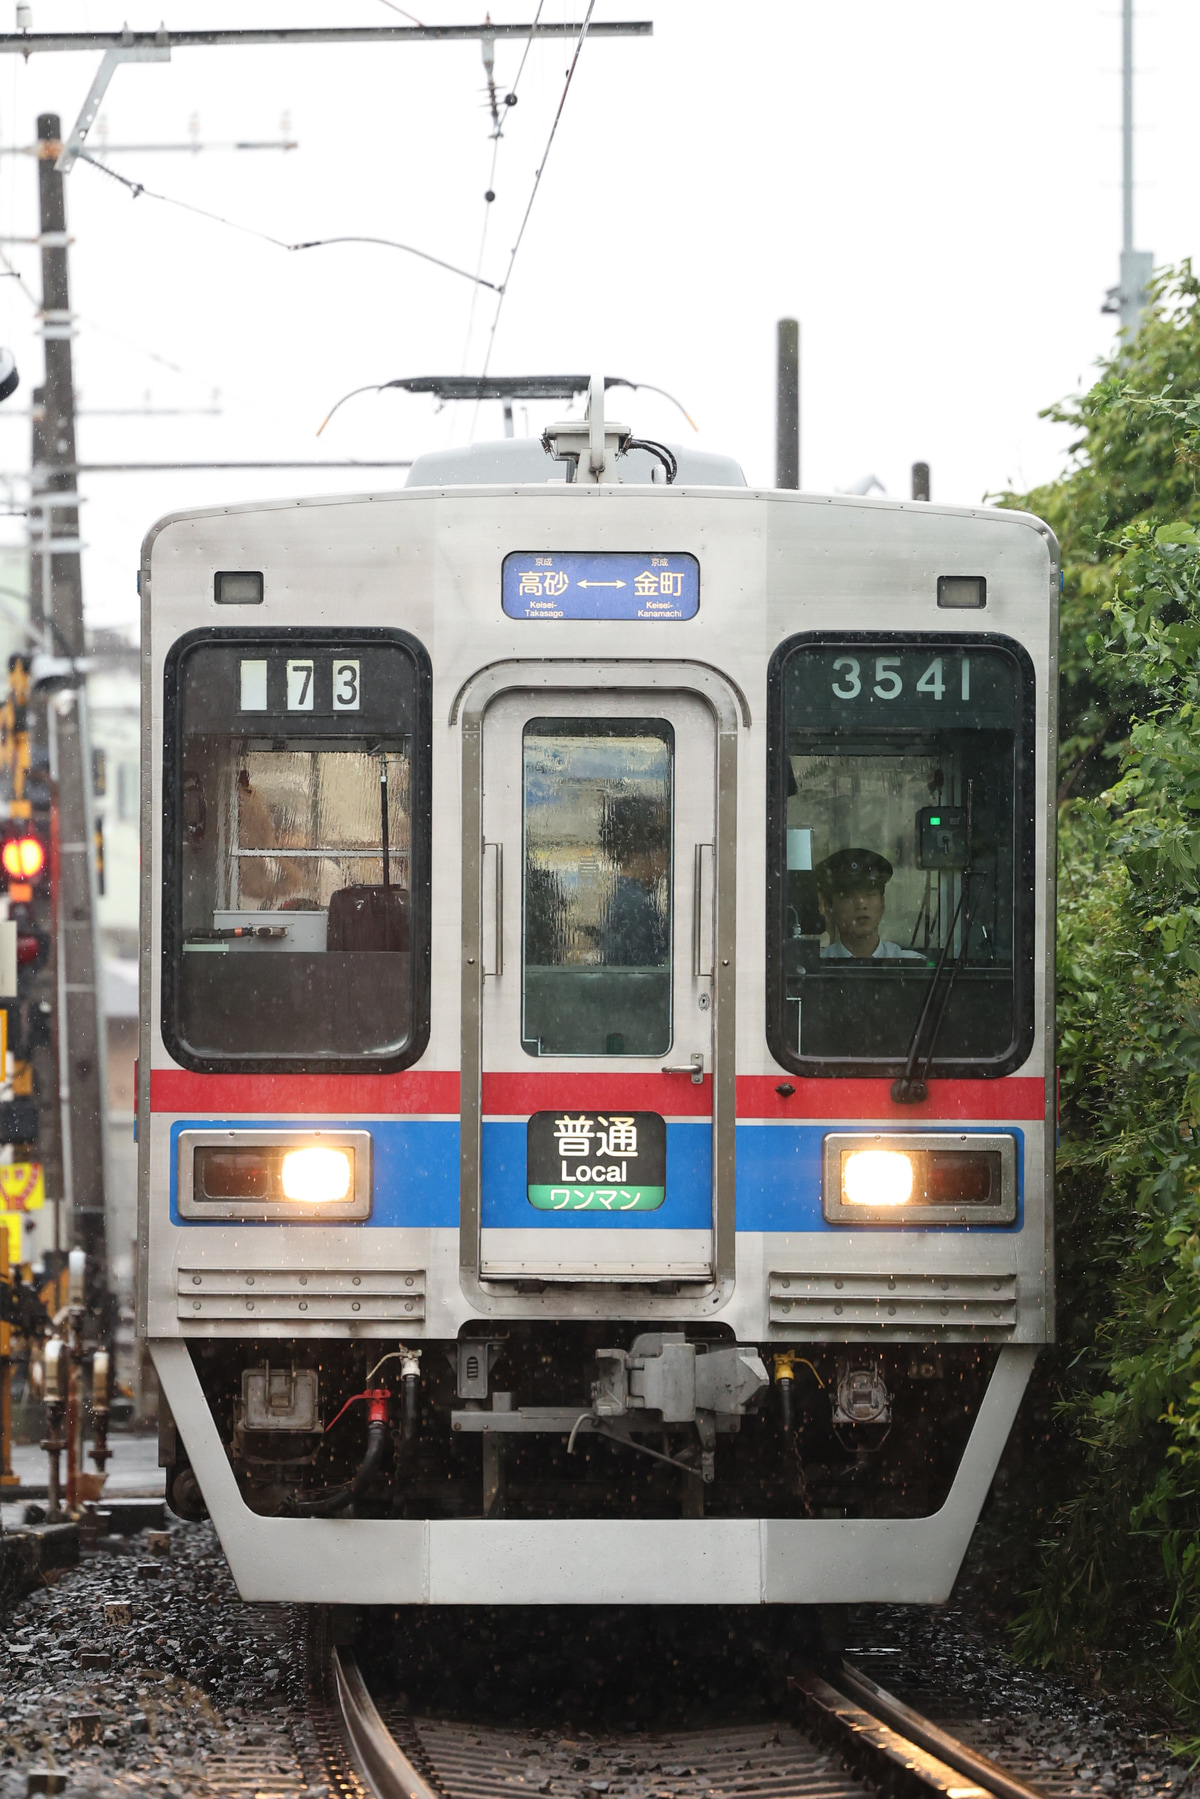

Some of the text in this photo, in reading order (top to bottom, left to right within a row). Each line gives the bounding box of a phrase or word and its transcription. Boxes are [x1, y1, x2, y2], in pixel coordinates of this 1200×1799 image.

[535, 557, 552, 566] 京成
[651, 557, 668, 566] 京成
[518, 570, 569, 596] 高砂
[633, 570, 684, 596] 金町
[525, 609, 563, 618] Takasago
[638, 609, 682, 617] Kanamachi
[831, 656, 970, 700] 3541
[553, 1115, 639, 1157] 普通
[561, 1160, 627, 1182] Local
[550, 1189, 641, 1210] ワンマン
